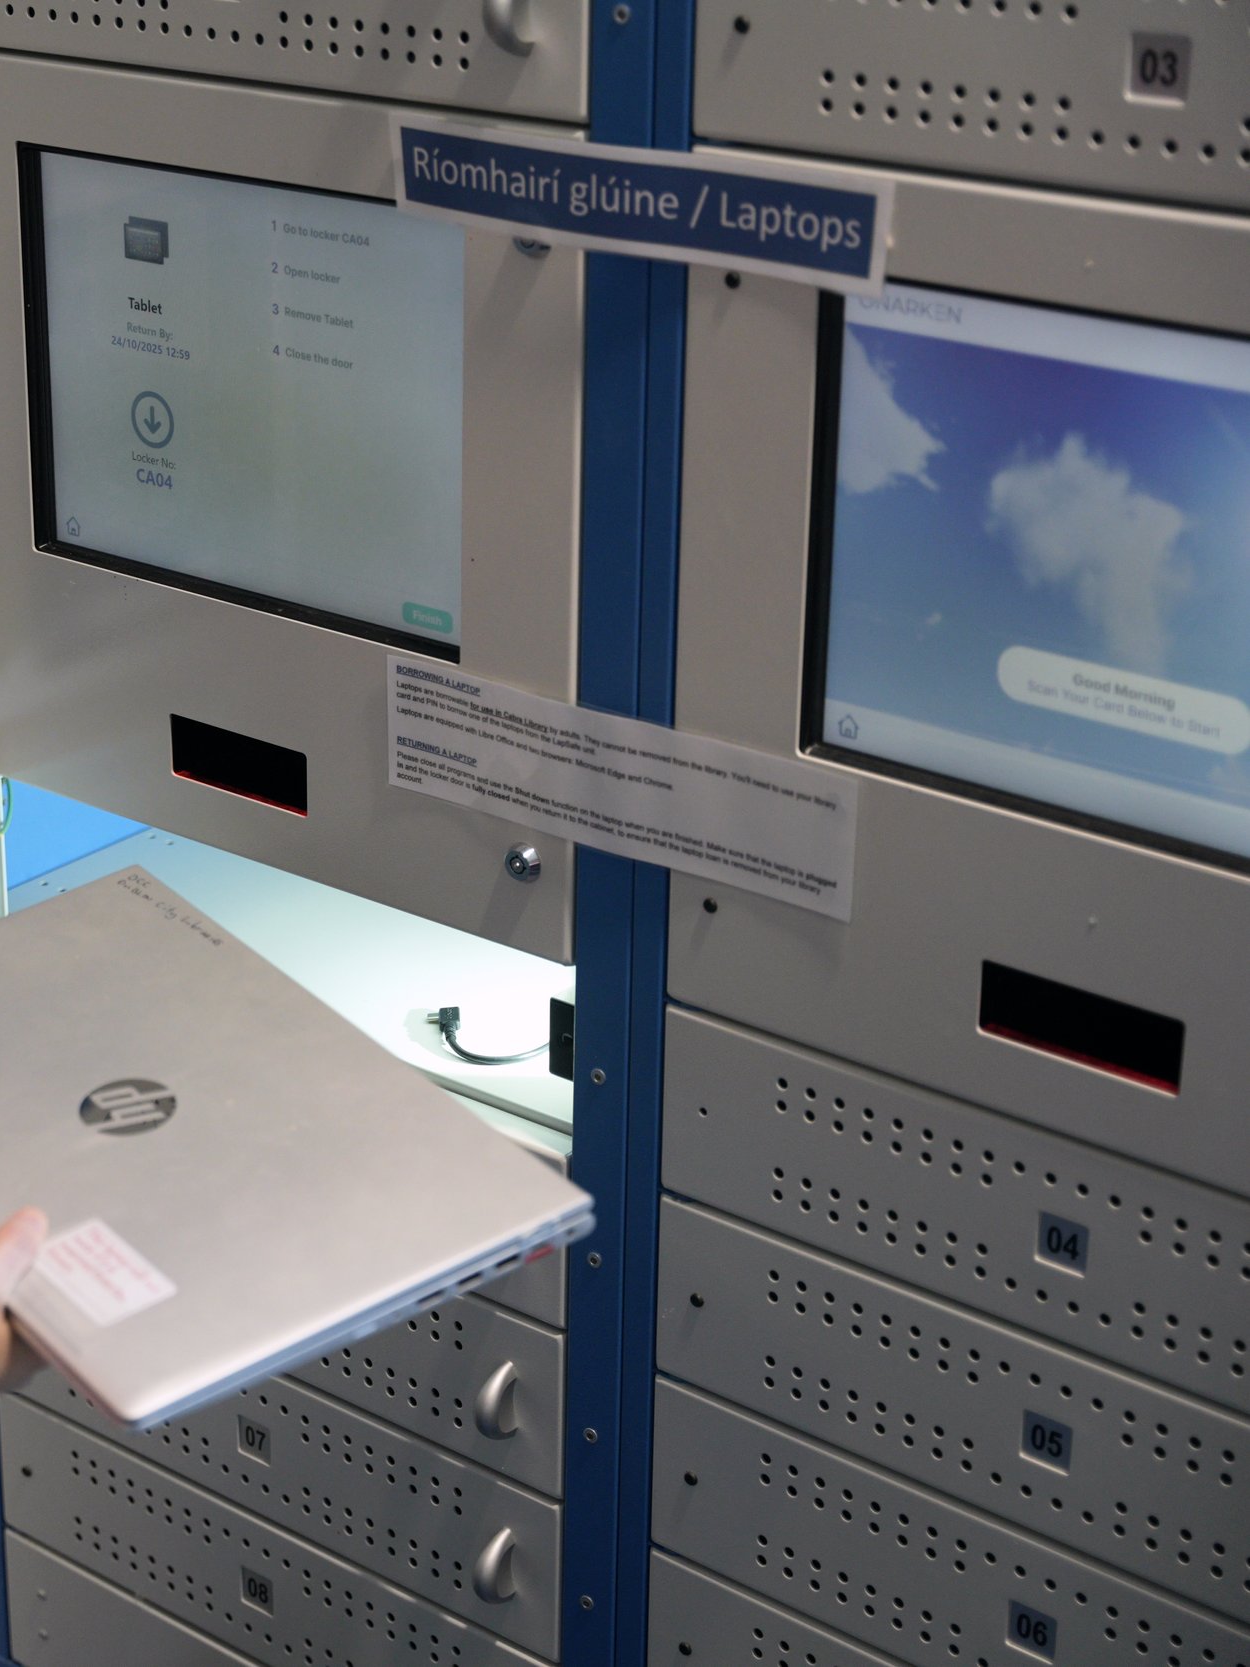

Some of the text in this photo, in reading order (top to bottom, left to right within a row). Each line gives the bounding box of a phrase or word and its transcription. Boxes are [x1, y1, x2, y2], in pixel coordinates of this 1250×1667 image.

[1140, 49, 1178, 87] 03
[413, 146, 862, 252] Ríomhairí glúine / Laptops
[272, 220, 370, 246] 1 Go to locker CA04
[271, 262, 340, 284] 2 Open locker
[128, 297, 162, 314] Tablet
[272, 304, 354, 328] 3 Remove Tablet
[127, 322, 173, 342] Return By:
[111, 336, 190, 360] 24/10/2025 12:59
[273, 345, 353, 369] 4 Close the door
[132, 451, 176, 470] Locker No:
[136, 468, 173, 489] CA04
[397, 665, 443, 684] BORROWING
[452, 680, 481, 694] LAPTOP
[1073, 673, 1176, 711] Good Morning
[397, 681, 548, 733] Laptops are for use Cabra Library
[397, 692, 524, 735] card and PIN to borrow one of the laptops
[1027, 680, 1221, 739] Scan Your Card Below to Start
[397, 706, 626, 780] Laptops are equipped with Libre Office and Microsoft Edge
[397, 735, 440, 755] RETURNING
[450, 750, 477, 765] LAPTOP
[397, 772, 423, 784] account.
[397, 751, 419, 763] Please
[420, 758, 437, 768] close
[447, 766, 475, 780] programs
[477, 775, 489, 785] and
[490, 780, 501, 789] use
[503, 783, 513, 793] the
[515, 787, 530, 799] Shut
[552, 799, 579, 813] function
[602, 813, 623, 827] laptop
[405, 764, 417, 773] and
[419, 767, 428, 776] the
[430, 770, 449, 782] locker
[450, 777, 464, 786] door
[472, 783, 487, 796] fully
[488, 789, 510, 801] closed
[511, 795, 528, 808] when
[530, 804, 542, 813] you
[543, 808, 561, 819] return
[1046, 1225, 1081, 1262] 04
[245, 1425, 266, 1451] 07
[1030, 1423, 1064, 1460] 05
[248, 1577, 269, 1604] 08
[1016, 1612, 1049, 1648] 06
